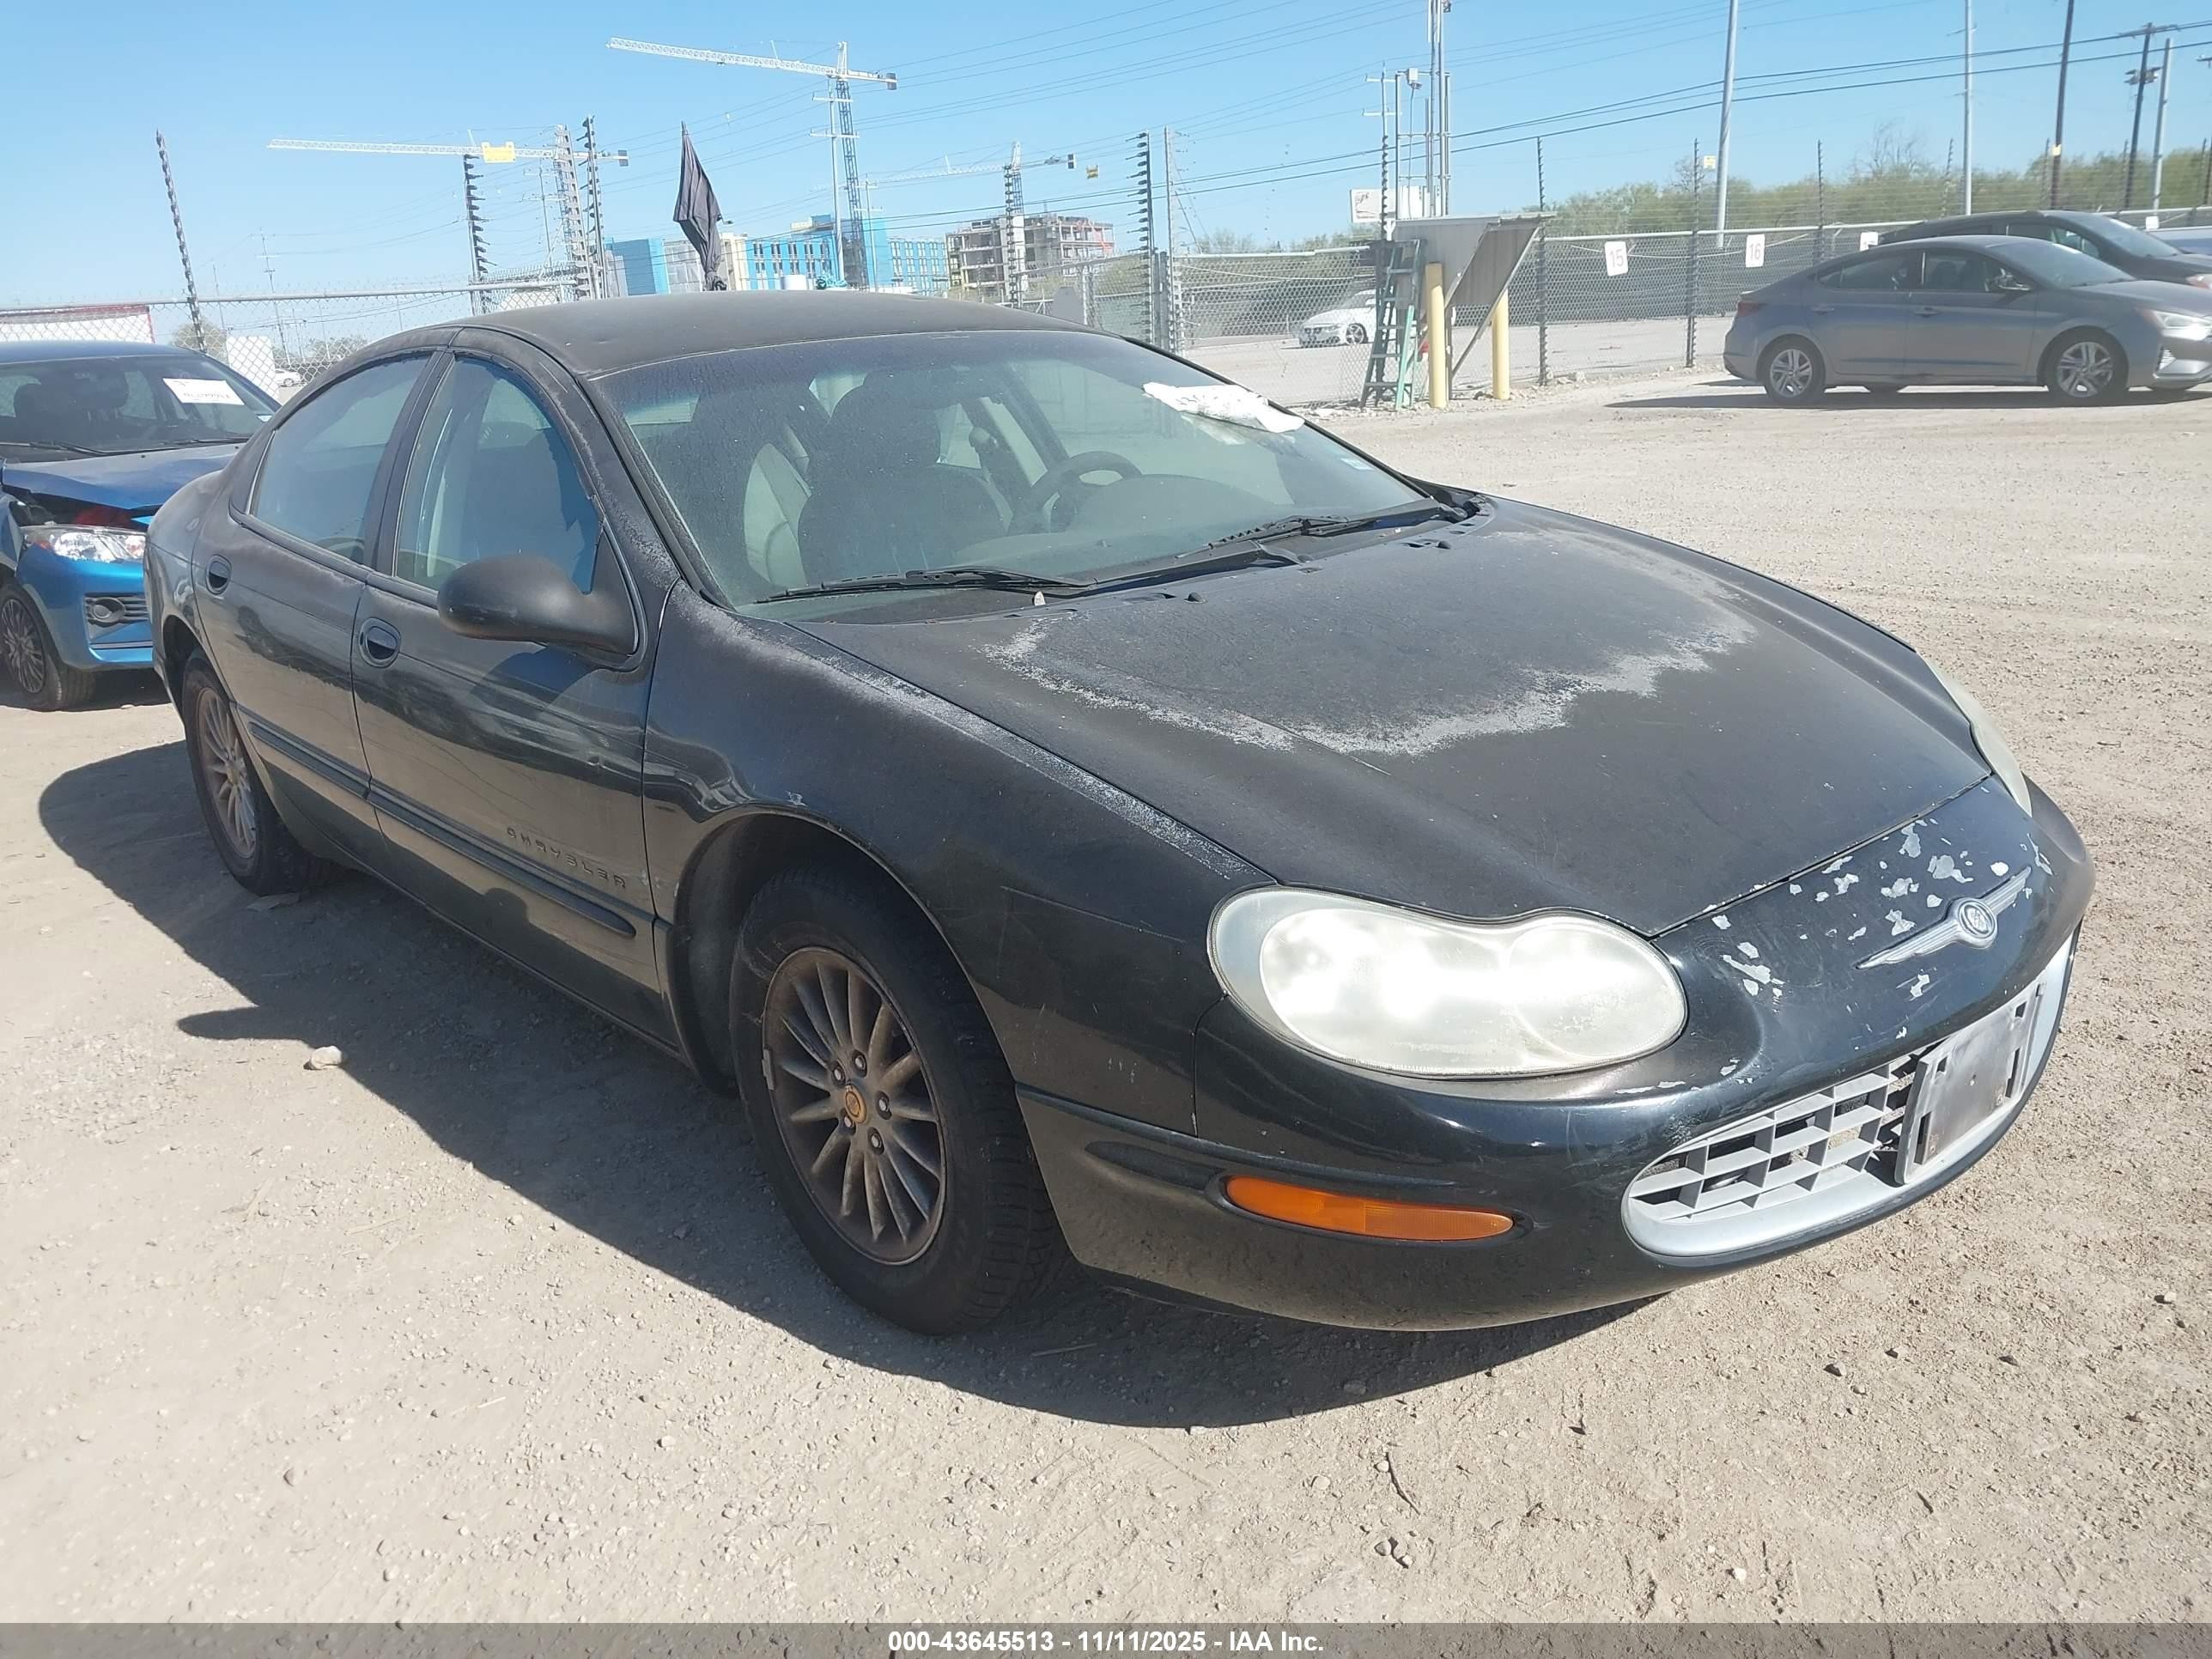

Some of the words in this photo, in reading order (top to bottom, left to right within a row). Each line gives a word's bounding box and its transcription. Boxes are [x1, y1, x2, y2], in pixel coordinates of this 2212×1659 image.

[1609, 248, 1624, 268] 15
[1749, 242, 1761, 260] 16
[506, 826, 626, 889] CHRYSLER
